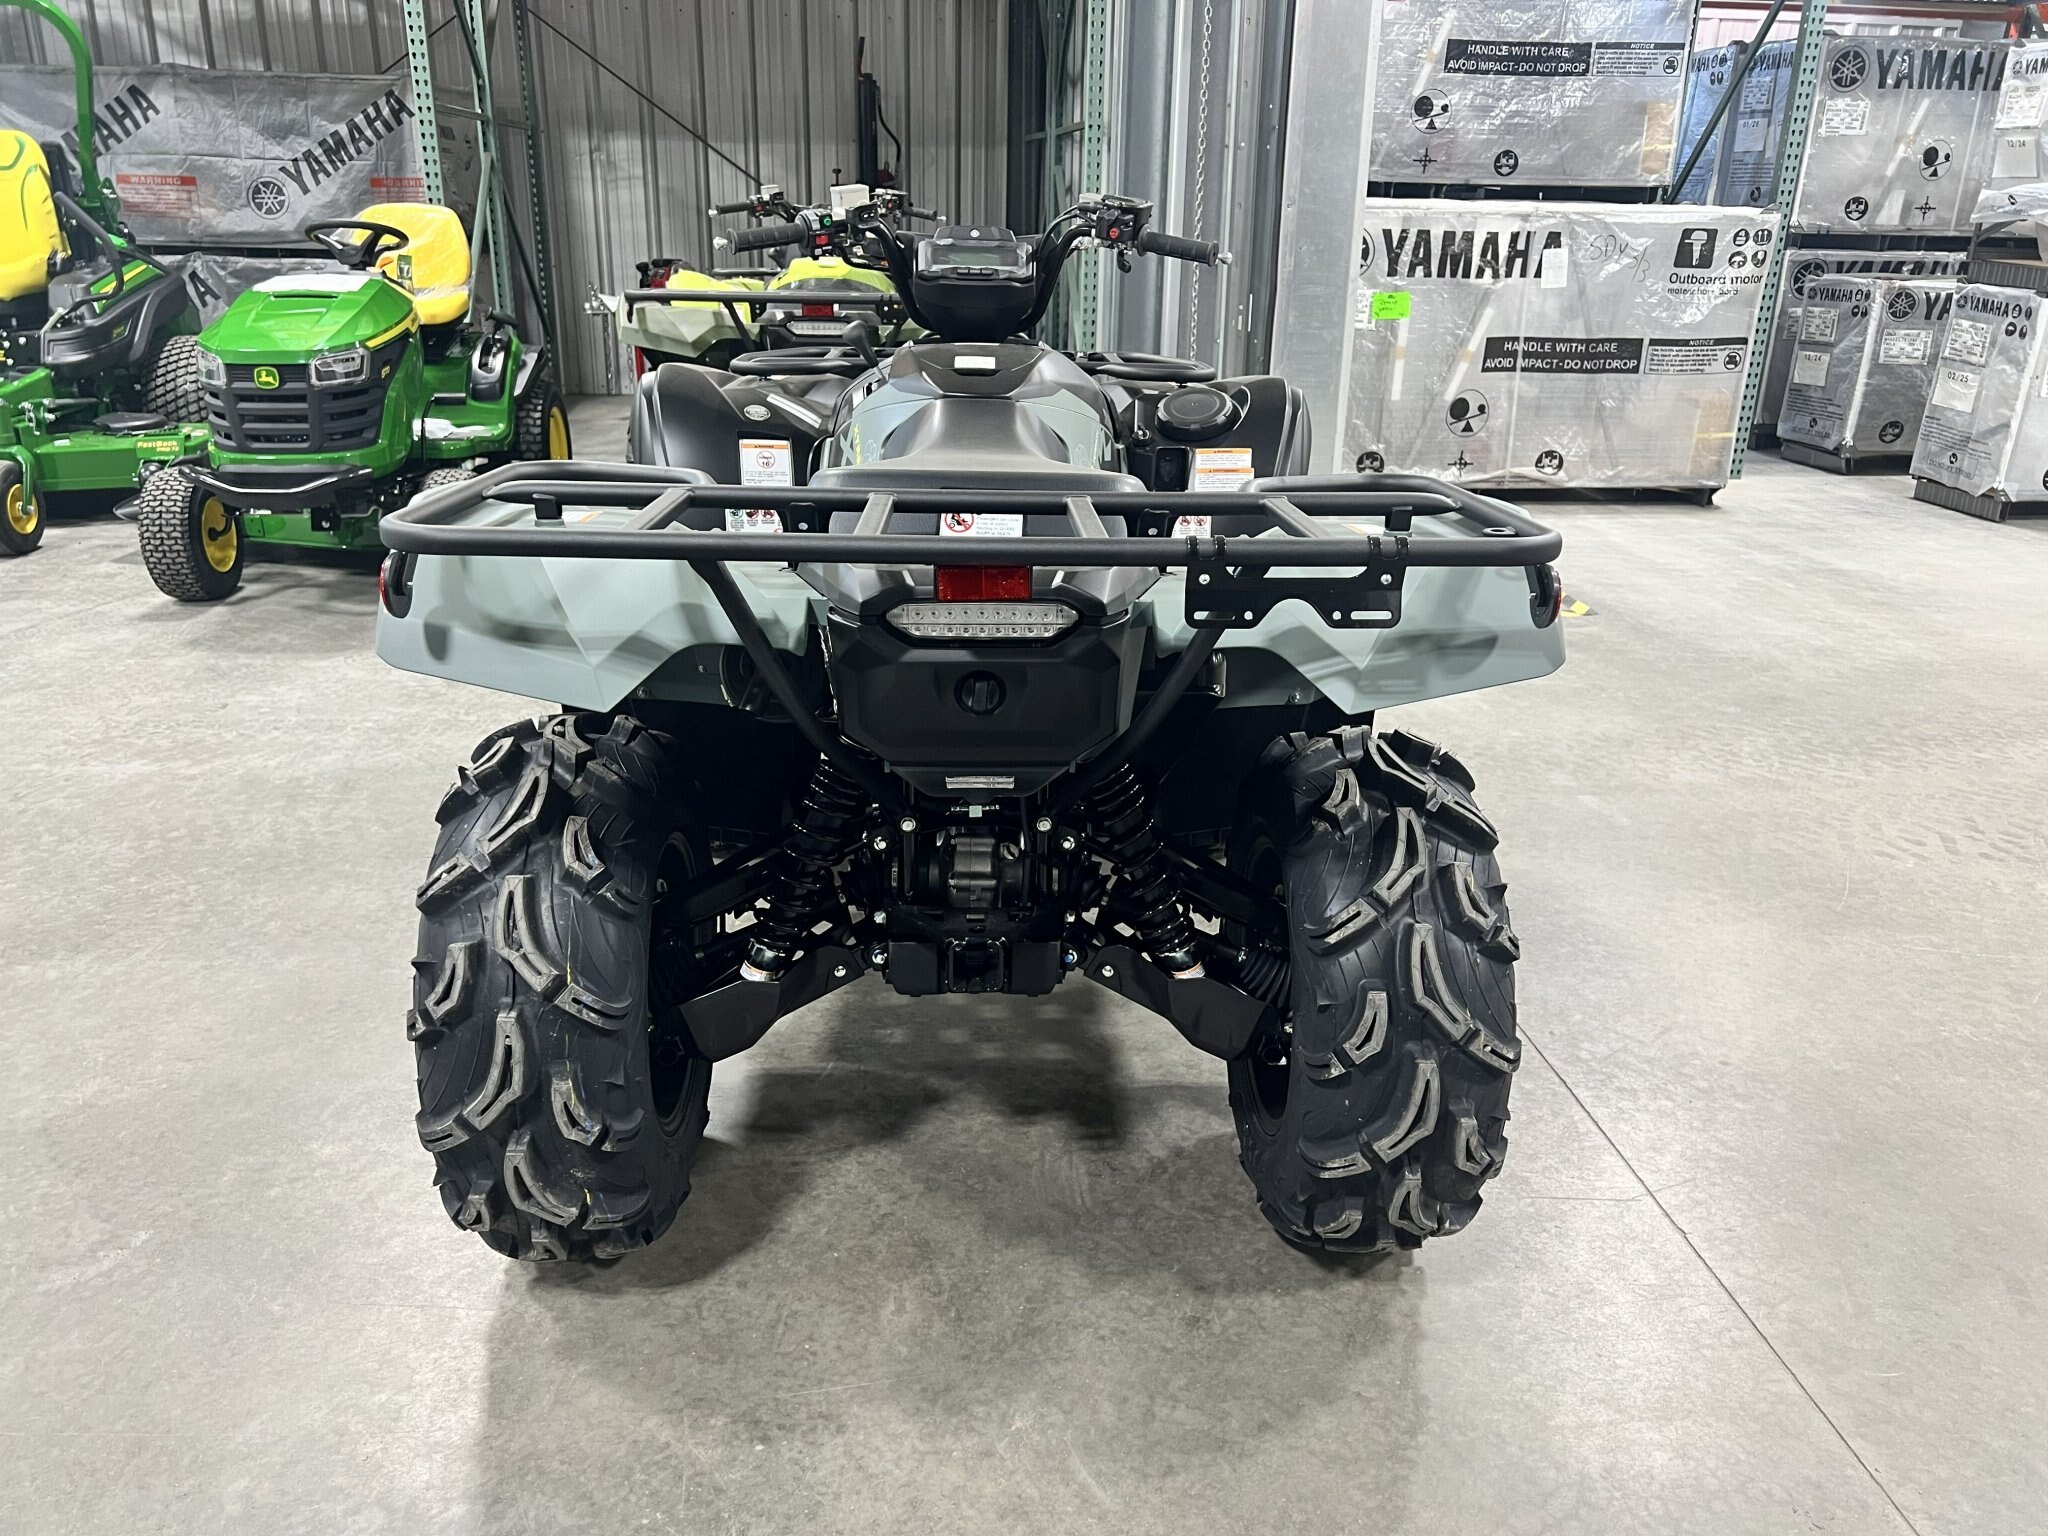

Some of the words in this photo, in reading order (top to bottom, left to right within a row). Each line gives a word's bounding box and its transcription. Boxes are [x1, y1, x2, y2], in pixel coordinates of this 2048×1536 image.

[1467, 44, 1509, 55] HANDLE
[1511, 46, 1538, 56] WITH
[1541, 47, 1569, 57] CARE
[1448, 59, 1477, 70] AVOID
[1535, 62, 1557, 72] NOT
[1558, 62, 1587, 73] DROP
[278, 89, 415, 196] YAMAHA
[130, 175, 182, 185] WARNING
[1669, 272, 1726, 285] Outboard
[1730, 274, 1763, 285] motor
[1819, 287, 1852, 303] YAMAHA
[1969, 295, 2009, 318] YAMAHA
[1504, 341, 1552, 352] HANDLE
[1555, 343, 1586, 353] WITH
[1589, 342, 1618, 353] CARE
[1484, 357, 1514, 368] AVOID
[1583, 359, 1605, 370] NOT
[1605, 359, 1638, 369] DROP
[1947, 370, 1969, 383] 02/25
